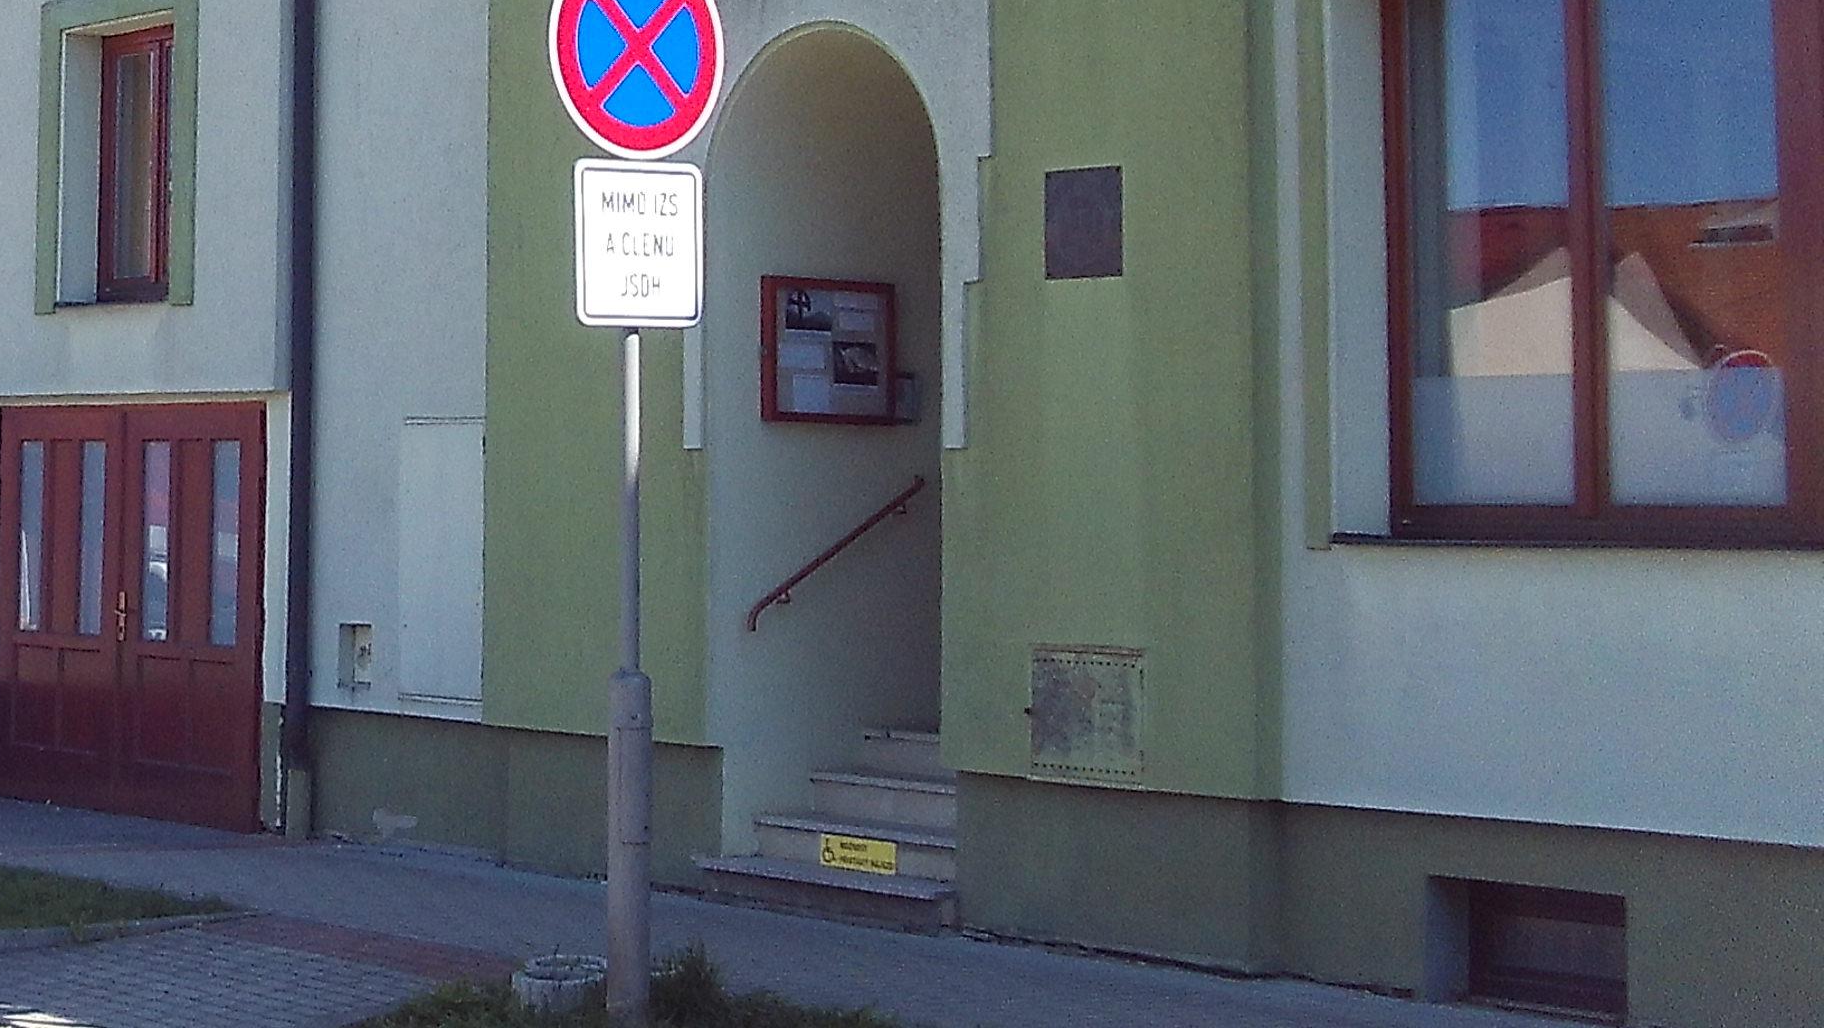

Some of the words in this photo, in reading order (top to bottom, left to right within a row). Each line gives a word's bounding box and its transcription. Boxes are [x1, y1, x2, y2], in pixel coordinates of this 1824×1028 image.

[601, 191, 646, 215] MIMO
[654, 192, 679, 217] IZS
[606, 232, 615, 254] A
